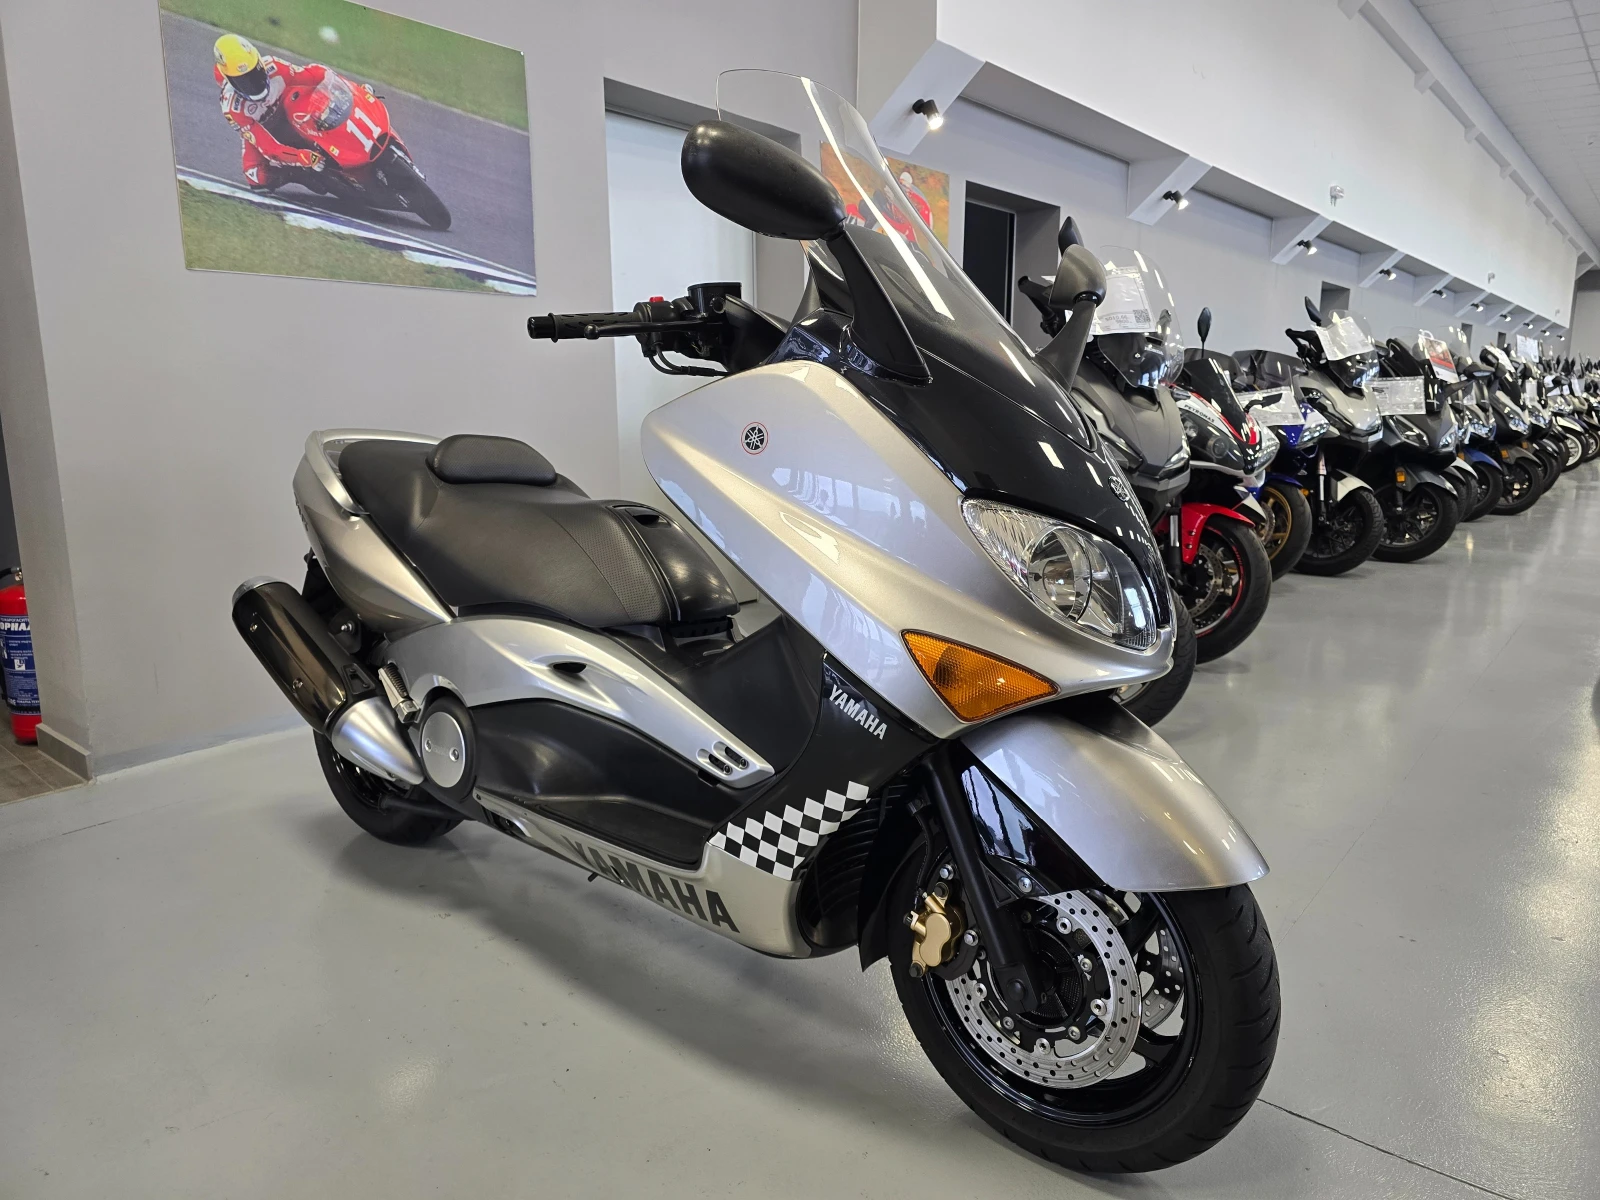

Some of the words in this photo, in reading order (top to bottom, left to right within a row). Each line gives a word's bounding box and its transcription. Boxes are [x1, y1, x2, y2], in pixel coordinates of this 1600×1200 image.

[346, 107, 382, 153] 11
[1184, 404, 1215, 423] PETRONAS
[827, 684, 888, 740] YAMAHA
[562, 835, 740, 933] YAMAHA
